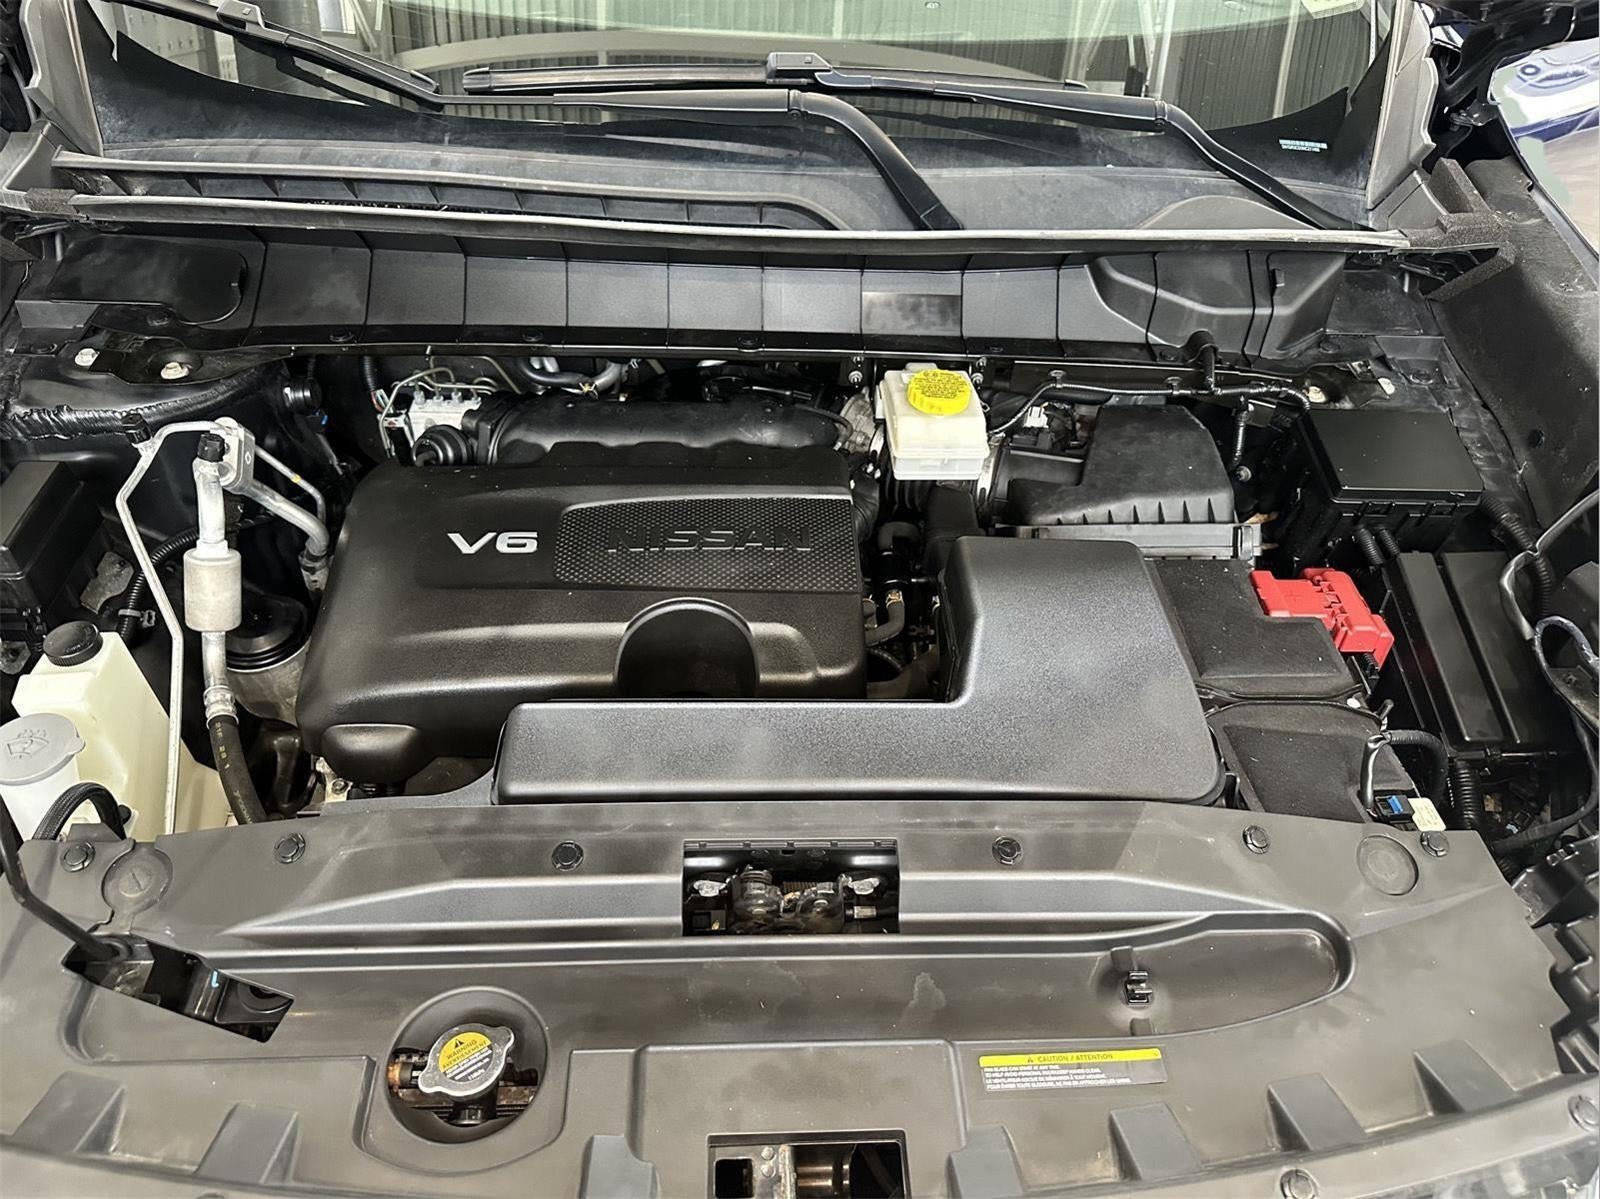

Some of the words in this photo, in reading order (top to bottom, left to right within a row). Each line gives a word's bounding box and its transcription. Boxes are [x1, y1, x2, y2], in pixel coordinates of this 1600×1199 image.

[447, 531, 538, 554] V6
[607, 526, 811, 552] NISSAN
[1037, 1055, 1069, 1063] CAUTION
[1075, 1053, 1113, 1061] ATTENTION
